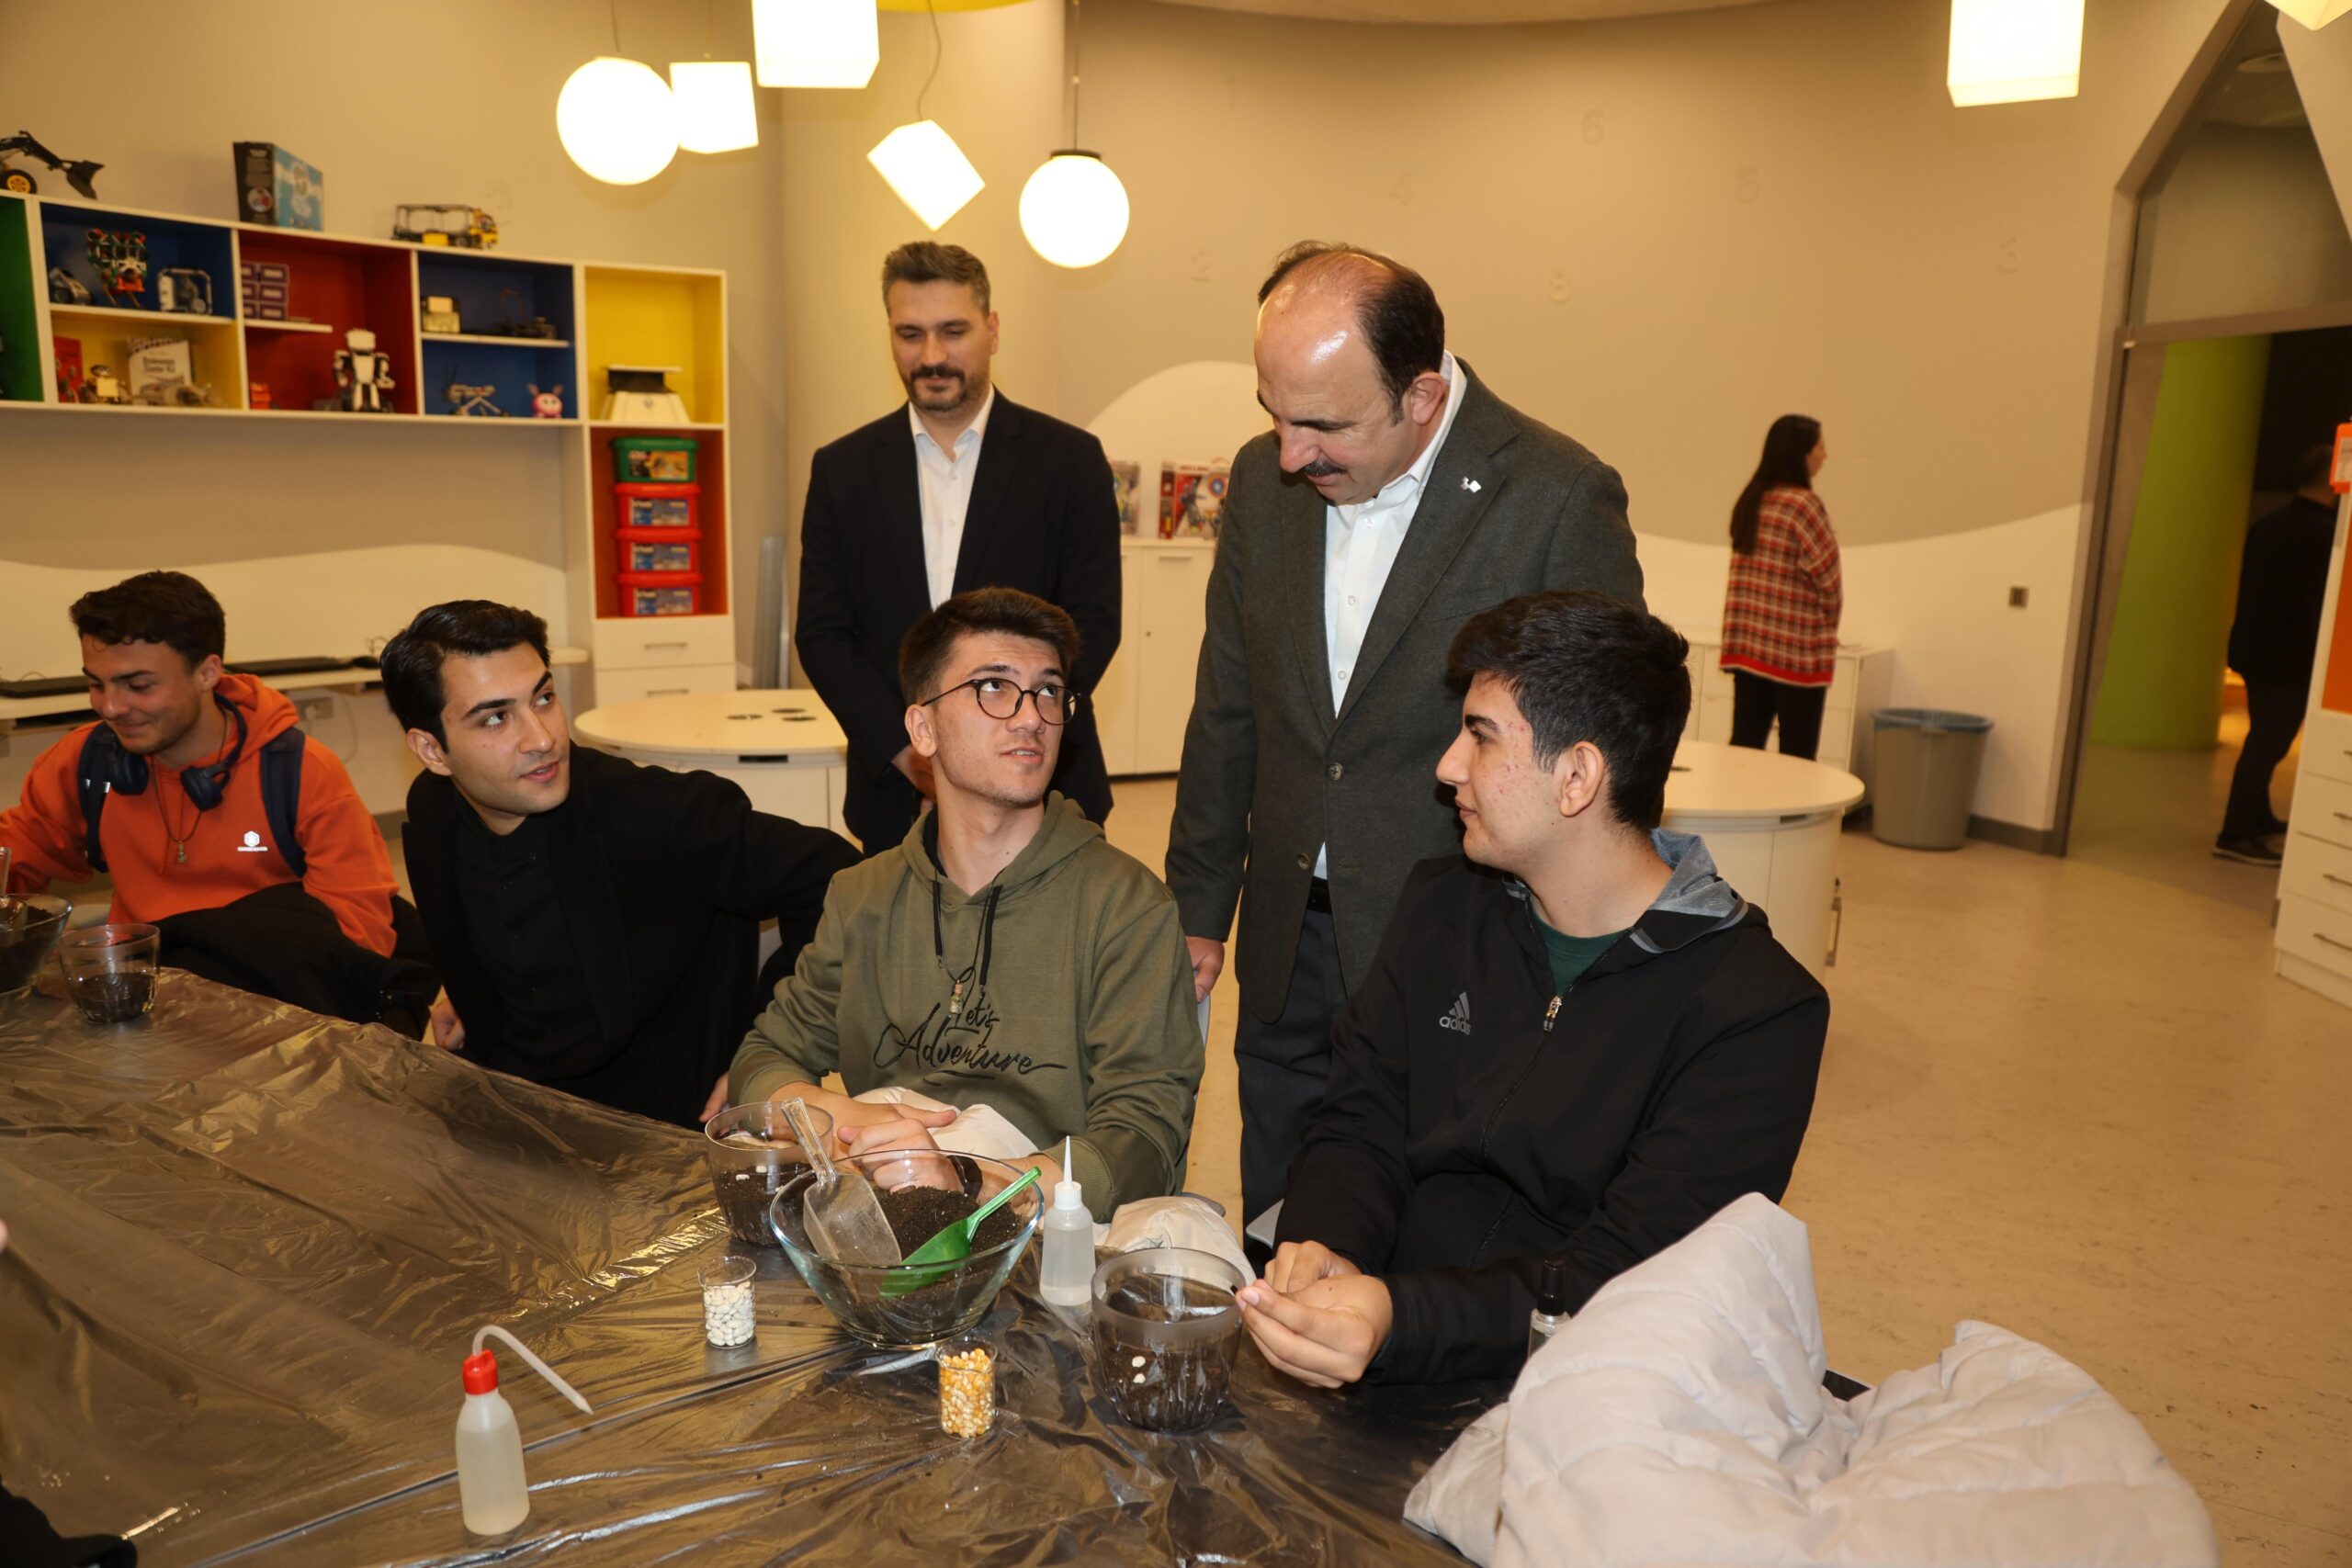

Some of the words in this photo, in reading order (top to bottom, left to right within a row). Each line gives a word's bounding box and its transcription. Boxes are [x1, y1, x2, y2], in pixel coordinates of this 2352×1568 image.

[1580, 108, 1607, 146] 6
[1735, 165, 1761, 204] 5
[874, 1002, 1068, 1075] Adventure
[1440, 1016, 1471, 1035] adids
